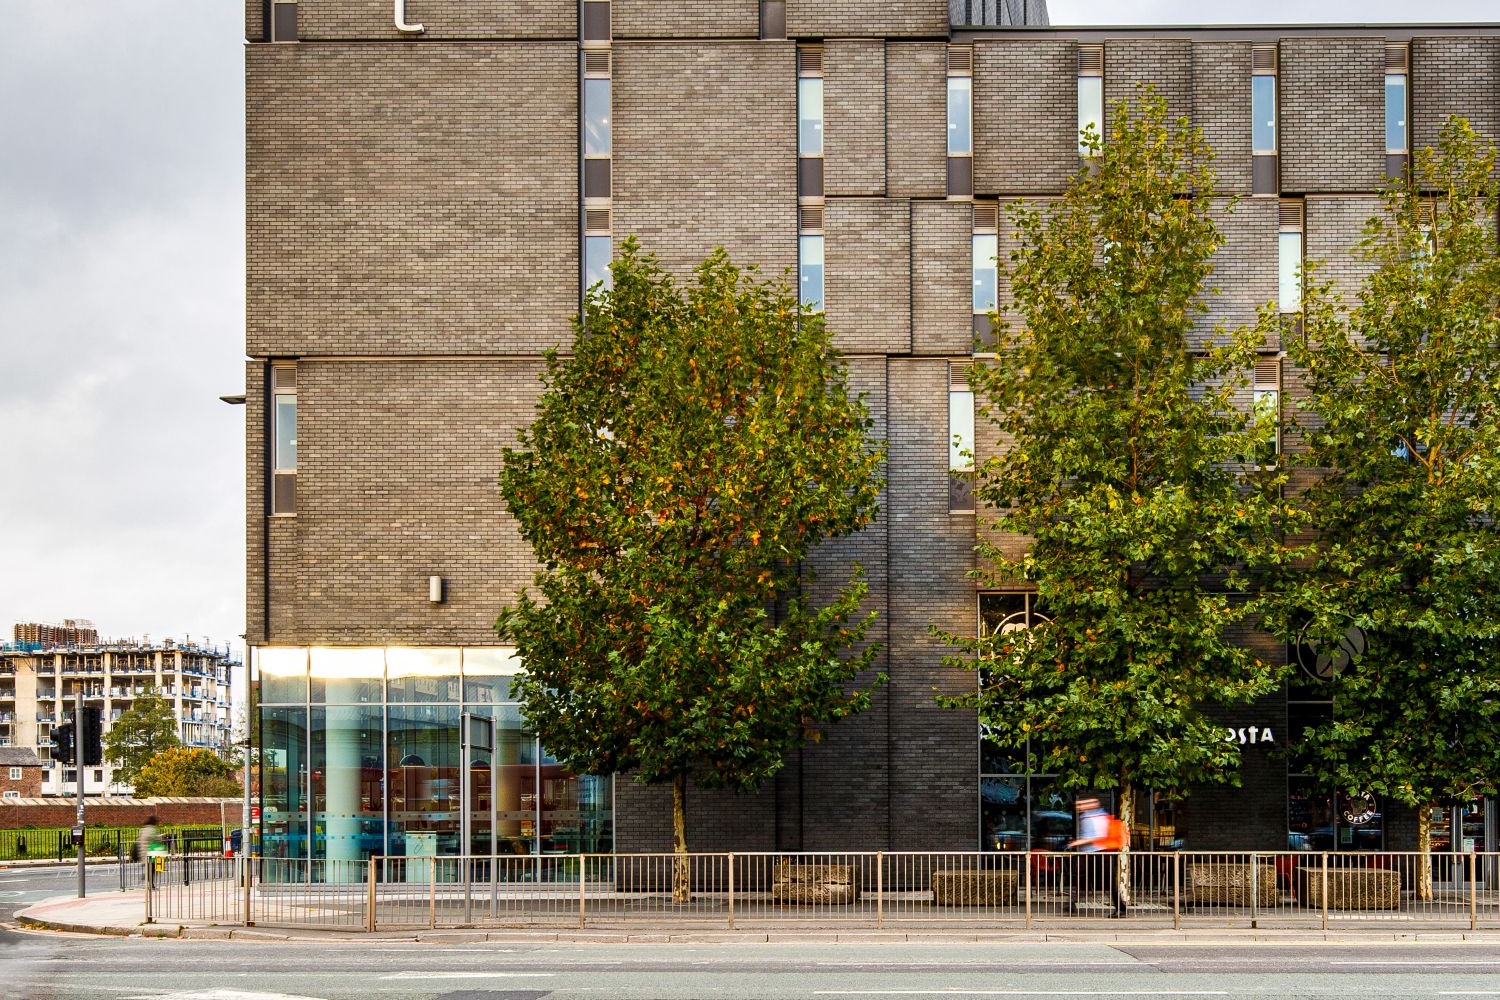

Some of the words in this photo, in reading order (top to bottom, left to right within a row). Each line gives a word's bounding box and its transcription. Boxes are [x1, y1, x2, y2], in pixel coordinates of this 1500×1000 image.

[1210, 725, 1275, 745] OSTA
[1345, 790, 1370, 801] CTA
[1343, 810, 1374, 823] COFFEE
